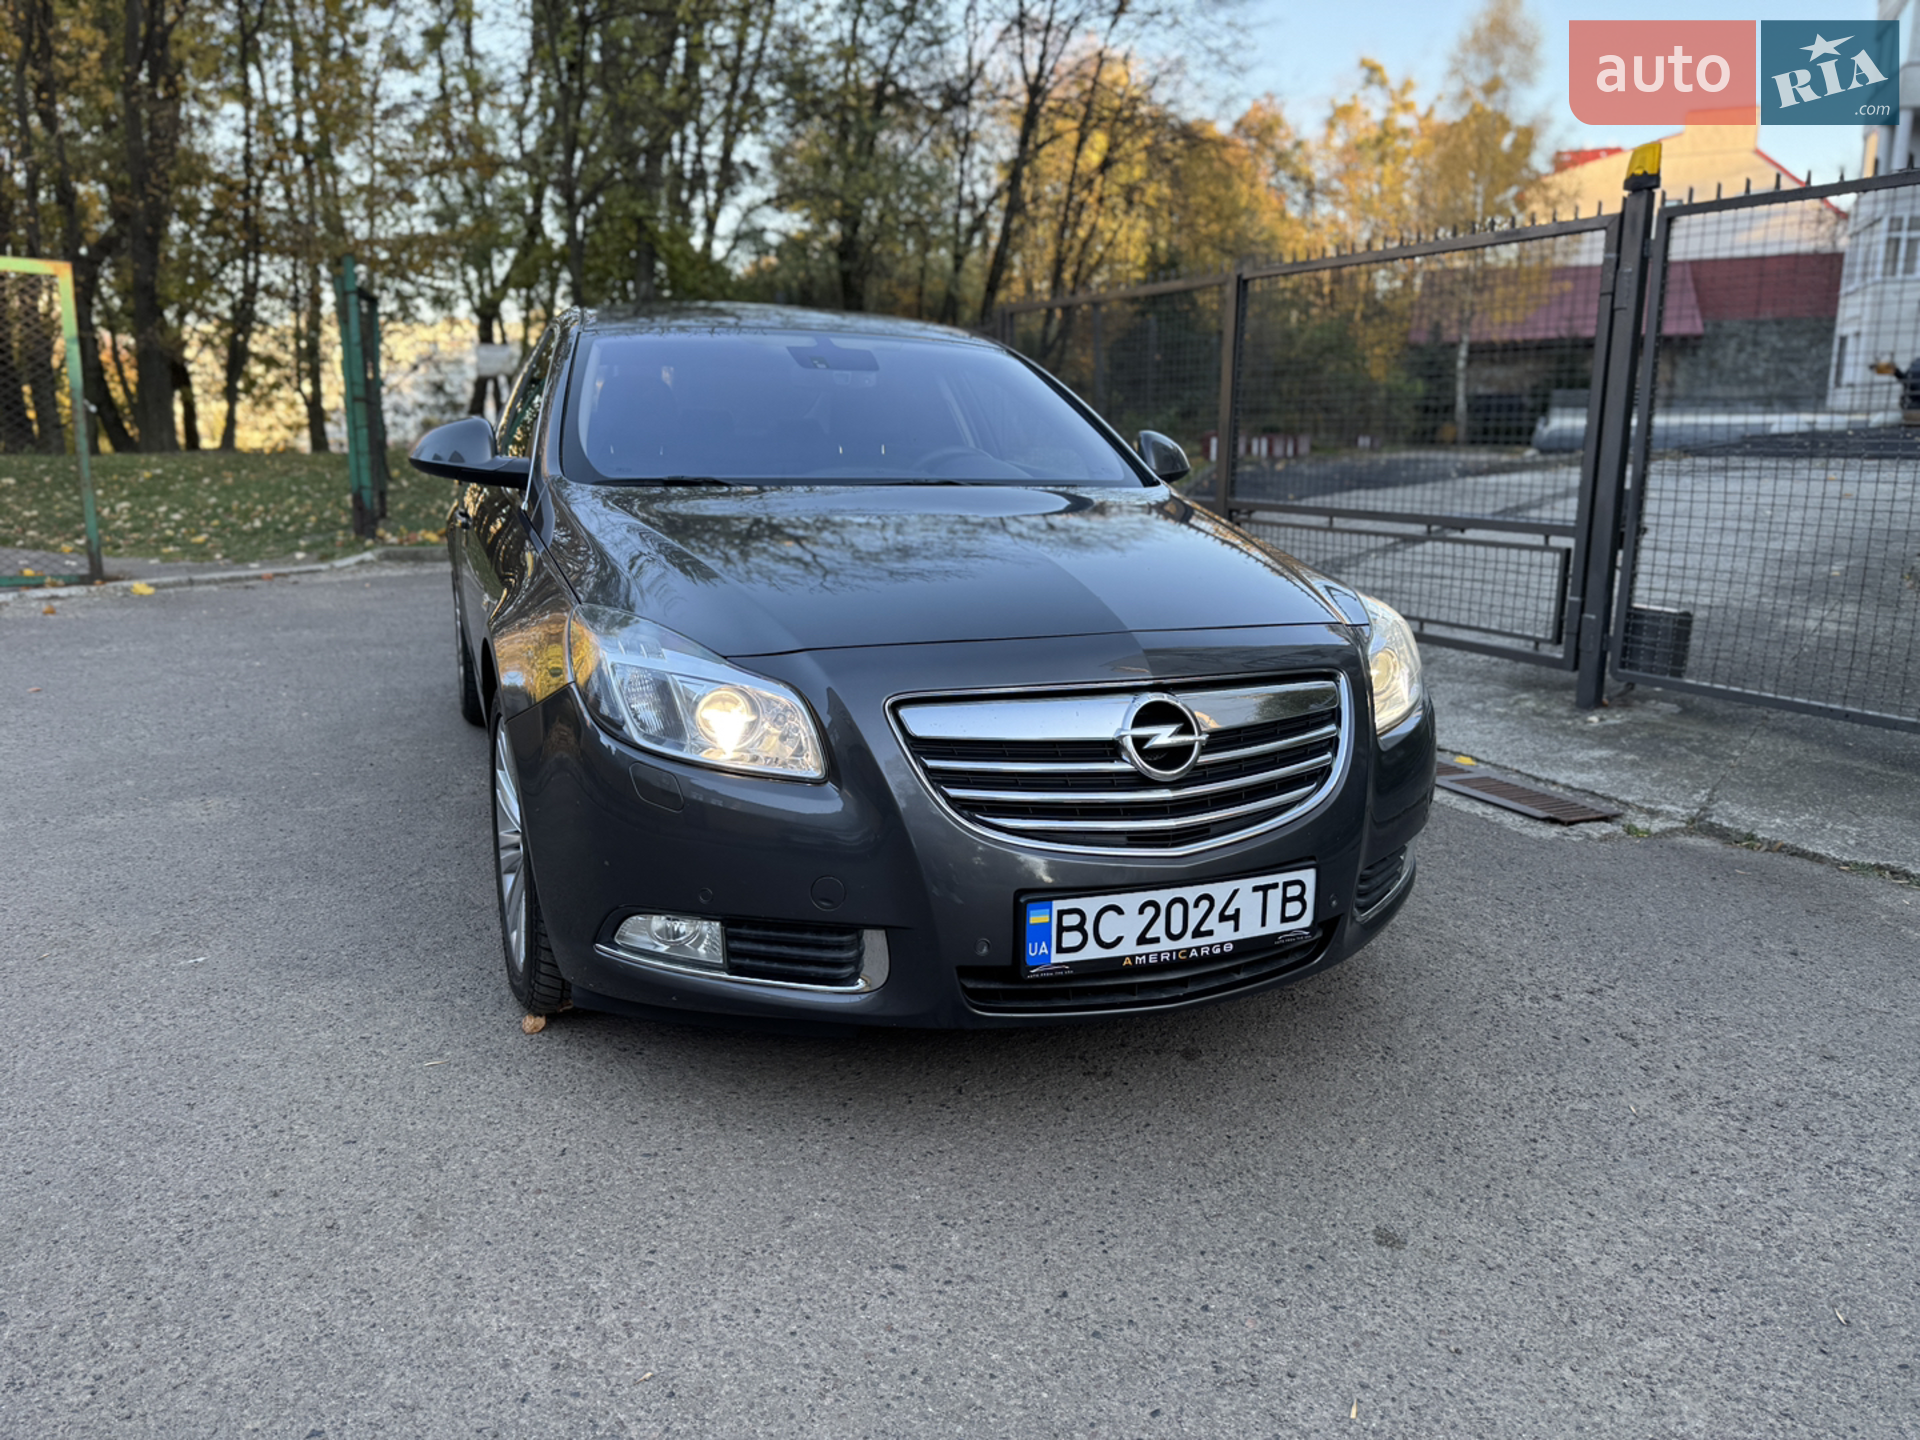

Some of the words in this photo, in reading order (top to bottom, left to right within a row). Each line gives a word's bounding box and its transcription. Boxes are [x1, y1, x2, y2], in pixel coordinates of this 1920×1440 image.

[1055, 904, 1125, 954] BC
[1136, 888, 1241, 947] 2024
[1251, 879, 1307, 928] TB
[1028, 940, 1049, 956] UA
